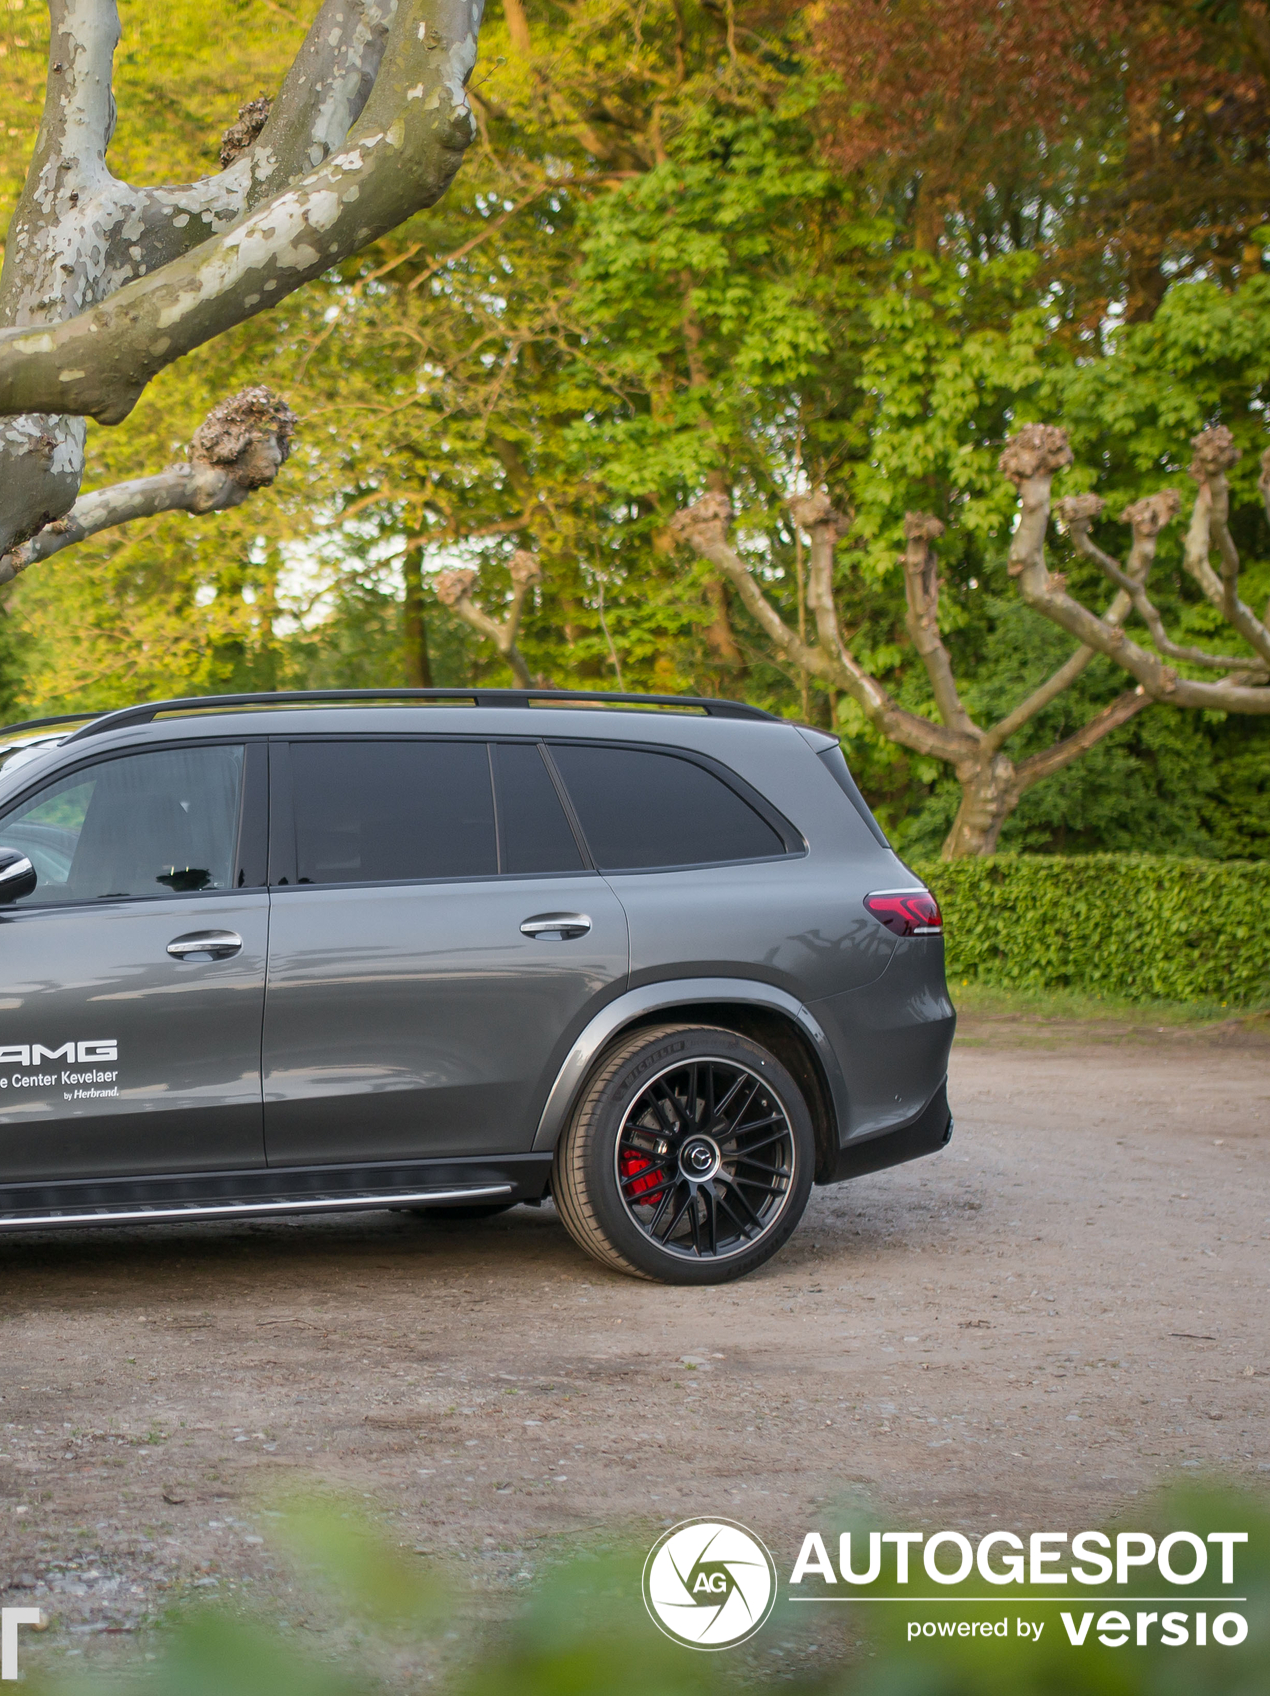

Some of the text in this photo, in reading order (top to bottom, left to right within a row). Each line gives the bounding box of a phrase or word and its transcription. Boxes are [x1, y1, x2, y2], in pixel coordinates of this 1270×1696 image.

[625, 1041, 683, 1087] MICHELIN
[11, 1073, 58, 1088] Center
[61, 1070, 119, 1085] Kevelaer
[63, 1091, 73, 1102] by
